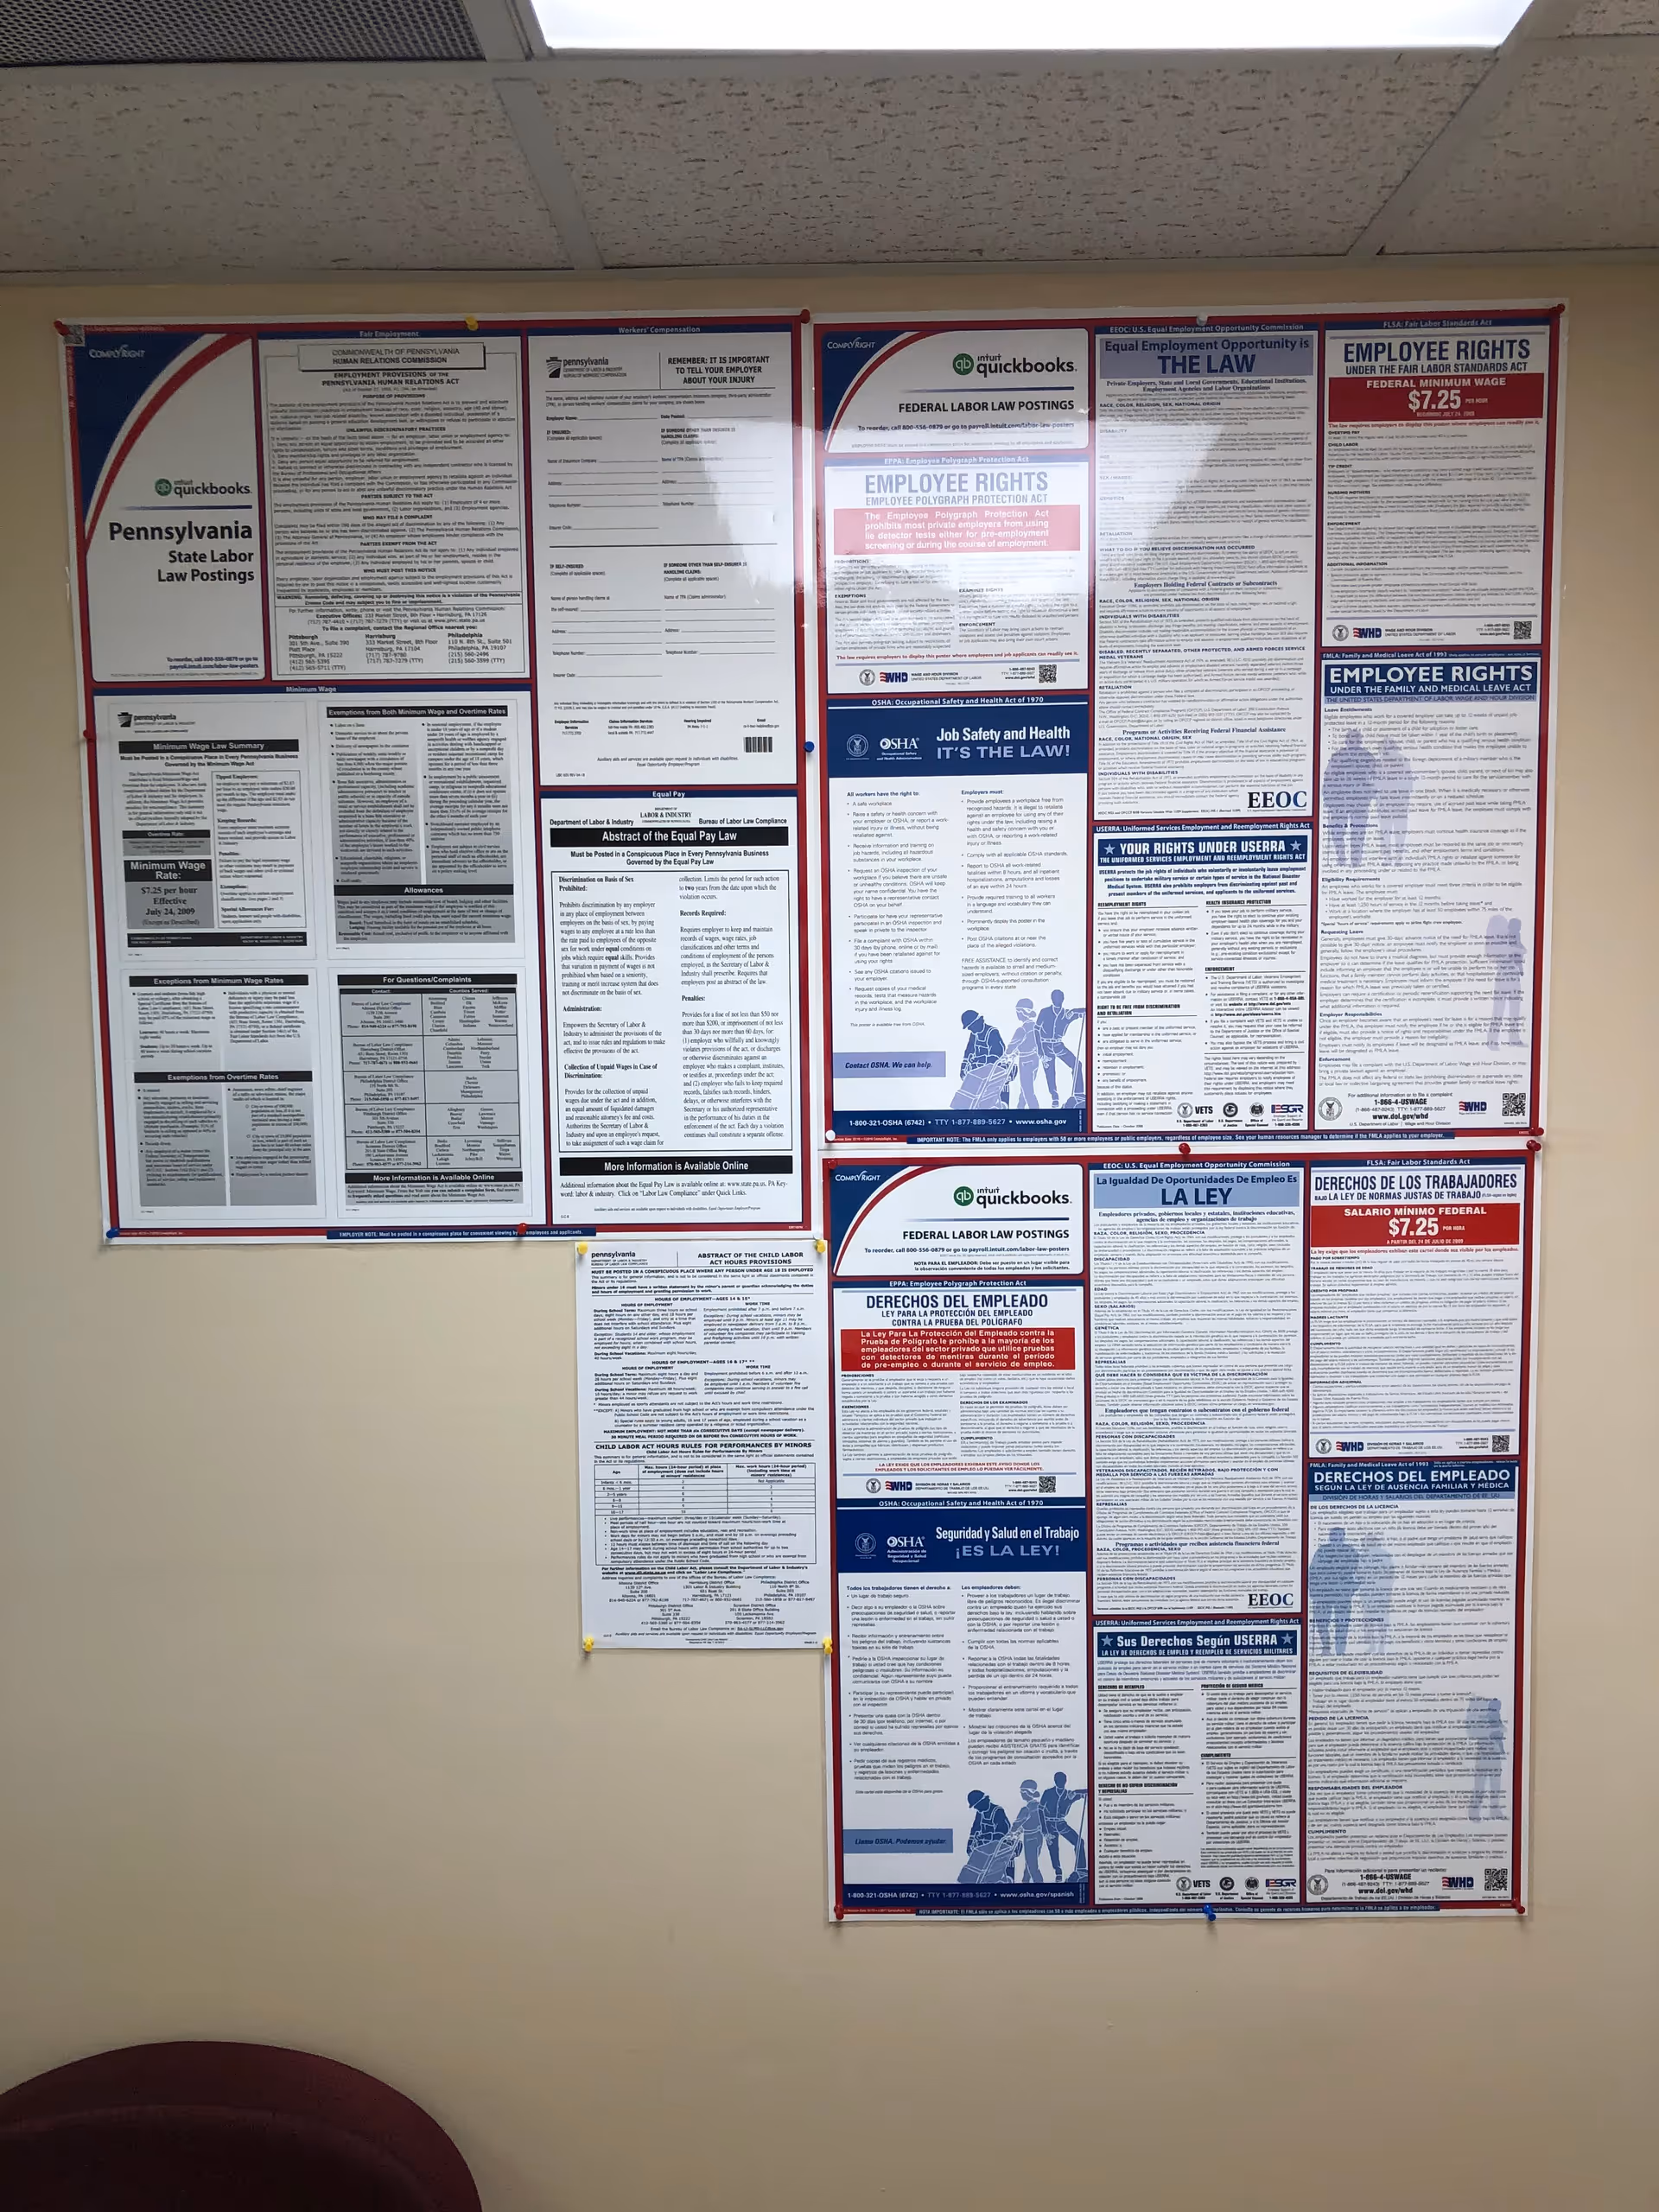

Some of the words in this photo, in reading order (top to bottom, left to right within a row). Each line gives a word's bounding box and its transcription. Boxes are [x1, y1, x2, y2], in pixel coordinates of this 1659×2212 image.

[374, 330, 420, 339] Employment
[1106, 340, 1138, 353] Equal
[1142, 340, 1217, 353] Employment
[1222, 338, 1297, 351] Opportunity
[1300, 338, 1309, 348] is
[1344, 340, 1449, 363] EMPLOYEE
[1457, 339, 1529, 360] RIGHTS
[563, 357, 608, 367] pennsylvania
[1158, 355, 1200, 374] THE
[1207, 354, 1255, 373] LAW
[1367, 379, 1415, 388] FEDERAL
[1420, 378, 1471, 387] MINIMUM
[1474, 378, 1505, 386] WAGE
[899, 403, 948, 412] FEDERAL
[951, 402, 988, 411] LABOR
[992, 402, 1015, 410] LAW
[1019, 400, 1073, 410] POSTINGS
[1408, 389, 1460, 413] $7.25
[866, 473, 968, 493] EMPLOYEE
[976, 472, 1047, 492] RIGHTS
[110, 521, 252, 545] Pennsylvania
[169, 550, 207, 563] State
[211, 549, 254, 563] Labor
[158, 569, 188, 582] Law
[191, 568, 254, 585] Postings
[1357, 628, 1382, 638] WHD
[1331, 666, 1443, 683] EMPLOYEE
[1452, 665, 1532, 681] RIGHTS
[937, 728, 959, 741] Job
[963, 727, 1001, 742] Safety
[1004, 727, 1026, 740] and
[1030, 726, 1070, 739] Health
[880, 738, 916, 749] OSHA
[938, 747, 970, 759] IT'S
[976, 747, 1013, 758] THE
[1021, 745, 1069, 757] LAW!
[1248, 791, 1306, 808] EEOC
[603, 831, 640, 841] Abstract
[643, 831, 652, 841] of
[655, 831, 668, 841] the
[671, 831, 696, 842] Equal
[700, 830, 715, 842] Pay
[719, 831, 736, 840] Law
[1120, 842, 1149, 855] YOUR
[1154, 842, 1194, 854] RIGHTS
[1199, 842, 1236, 853] UNDER
[1242, 841, 1285, 852] USERRA
[131, 861, 175, 873] Minimum
[178, 861, 206, 871] Wage
[146, 908, 162, 917] July
[702, 909, 726, 918] Required:
[397, 976, 472, 985] Questions/Complaints
[918, 1061, 933, 1070] help.
[1464, 1102, 1486, 1111] WHD
[1109, 1177, 1148, 1186] Igualdad
[1166, 1176, 1234, 1185] Oportunidades
[1251, 1175, 1285, 1185] Empleo
[1315, 1176, 1376, 1191] DERECHOS
[1381, 1176, 1395, 1190] DE
[1400, 1175, 1421, 1190] LOS
[1426, 1174, 1516, 1189] TRABAJADORES
[1162, 1188, 1188, 1205] LA
[1195, 1188, 1232, 1205] LEY
[1395, 1206, 1435, 1215] MÍNIMO
[1389, 1217, 1438, 1237] $7.25
[952, 1230, 988, 1239] LABOR
[1016, 1230, 1069, 1238] POSTINGS
[868, 1295, 938, 1308] DERECHOS
[944, 1295, 969, 1307] DEL
[974, 1294, 1047, 1307] EMPLEADO
[1339, 1442, 1363, 1452] WHD
[1315, 1471, 1393, 1483] DERECHOS
[1399, 1471, 1426, 1482] DEL
[1431, 1470, 1510, 1481] EMPLEADO
[937, 1527, 982, 1541] Seguridad
[985, 1530, 989, 1541] y
[992, 1527, 1018, 1538] Salud
[1033, 1527, 1042, 1538] el
[1044, 1527, 1078, 1541] Trabajo
[887, 1536, 925, 1547] OSHA
[957, 1545, 983, 1559] ¡ES
[990, 1545, 1014, 1556] LA
[1020, 1545, 1058, 1555] LEY!
[1249, 1593, 1293, 1606] EEOC
[1117, 1636, 1136, 1646] Sus
[1141, 1636, 1192, 1646] Derechos
[1197, 1635, 1230, 1648] Según
[1235, 1635, 1277, 1645] USERRA
[1448, 1877, 1473, 1888] WHD
